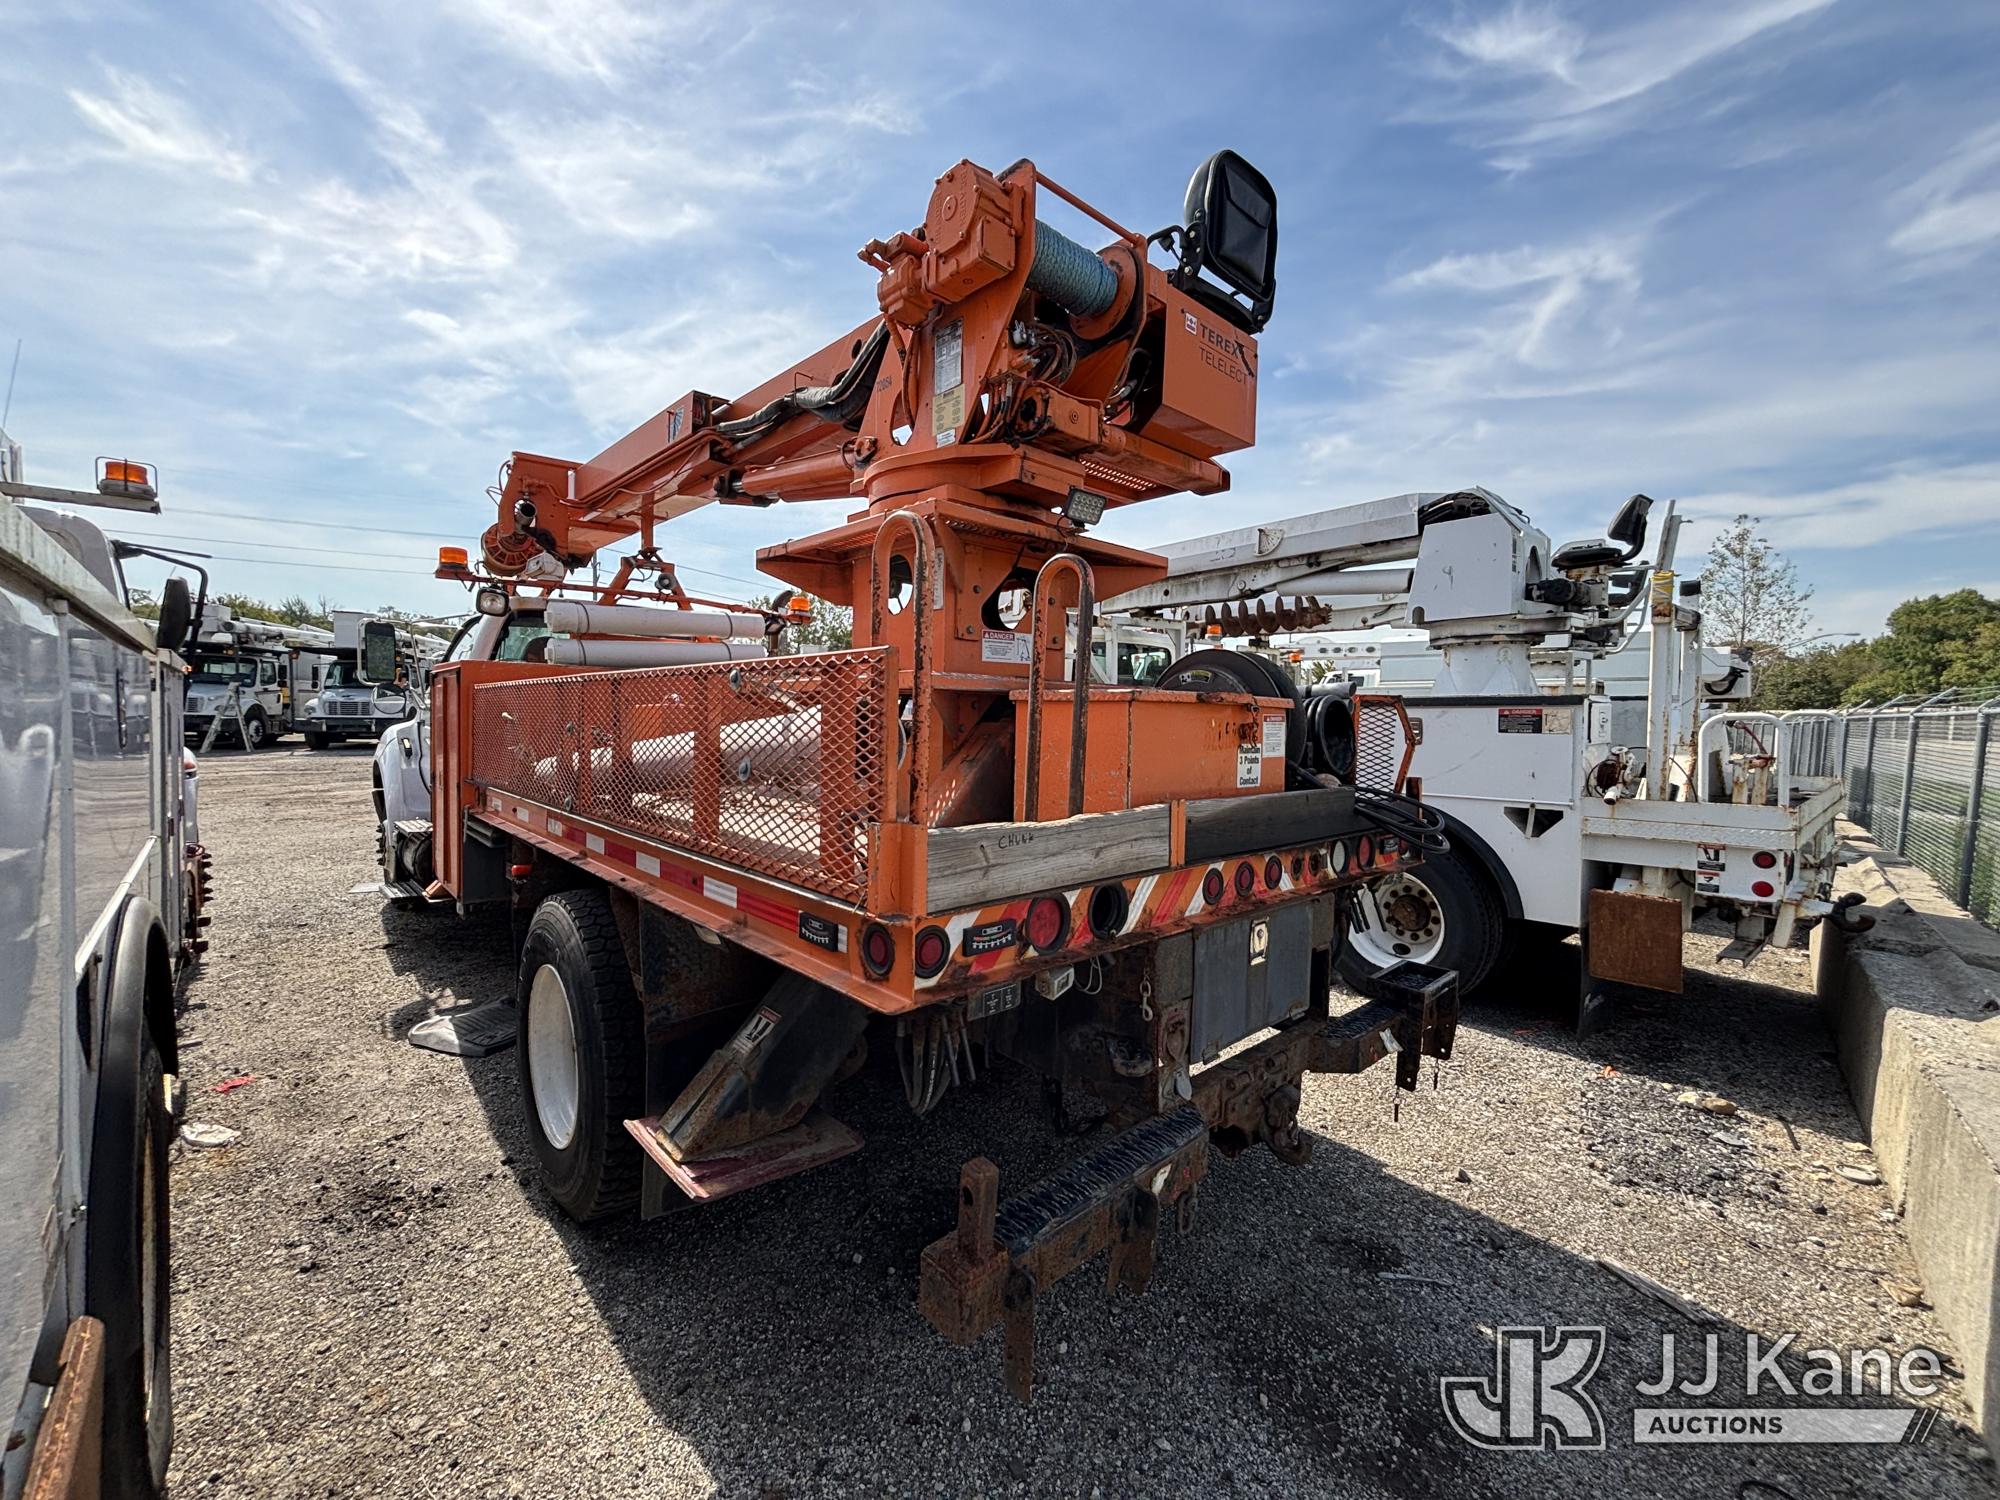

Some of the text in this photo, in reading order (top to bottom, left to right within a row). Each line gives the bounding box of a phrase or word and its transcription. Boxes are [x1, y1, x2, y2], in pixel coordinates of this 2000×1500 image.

[1200, 323, 1244, 360] TEREX
[1200, 346, 1248, 385] TELELECT
[989, 632, 1014, 640] DANGER
[1240, 755, 1259, 765] 3 Points
[1246, 766, 1252, 775] of
[1240, 776, 1258, 785] Contact
